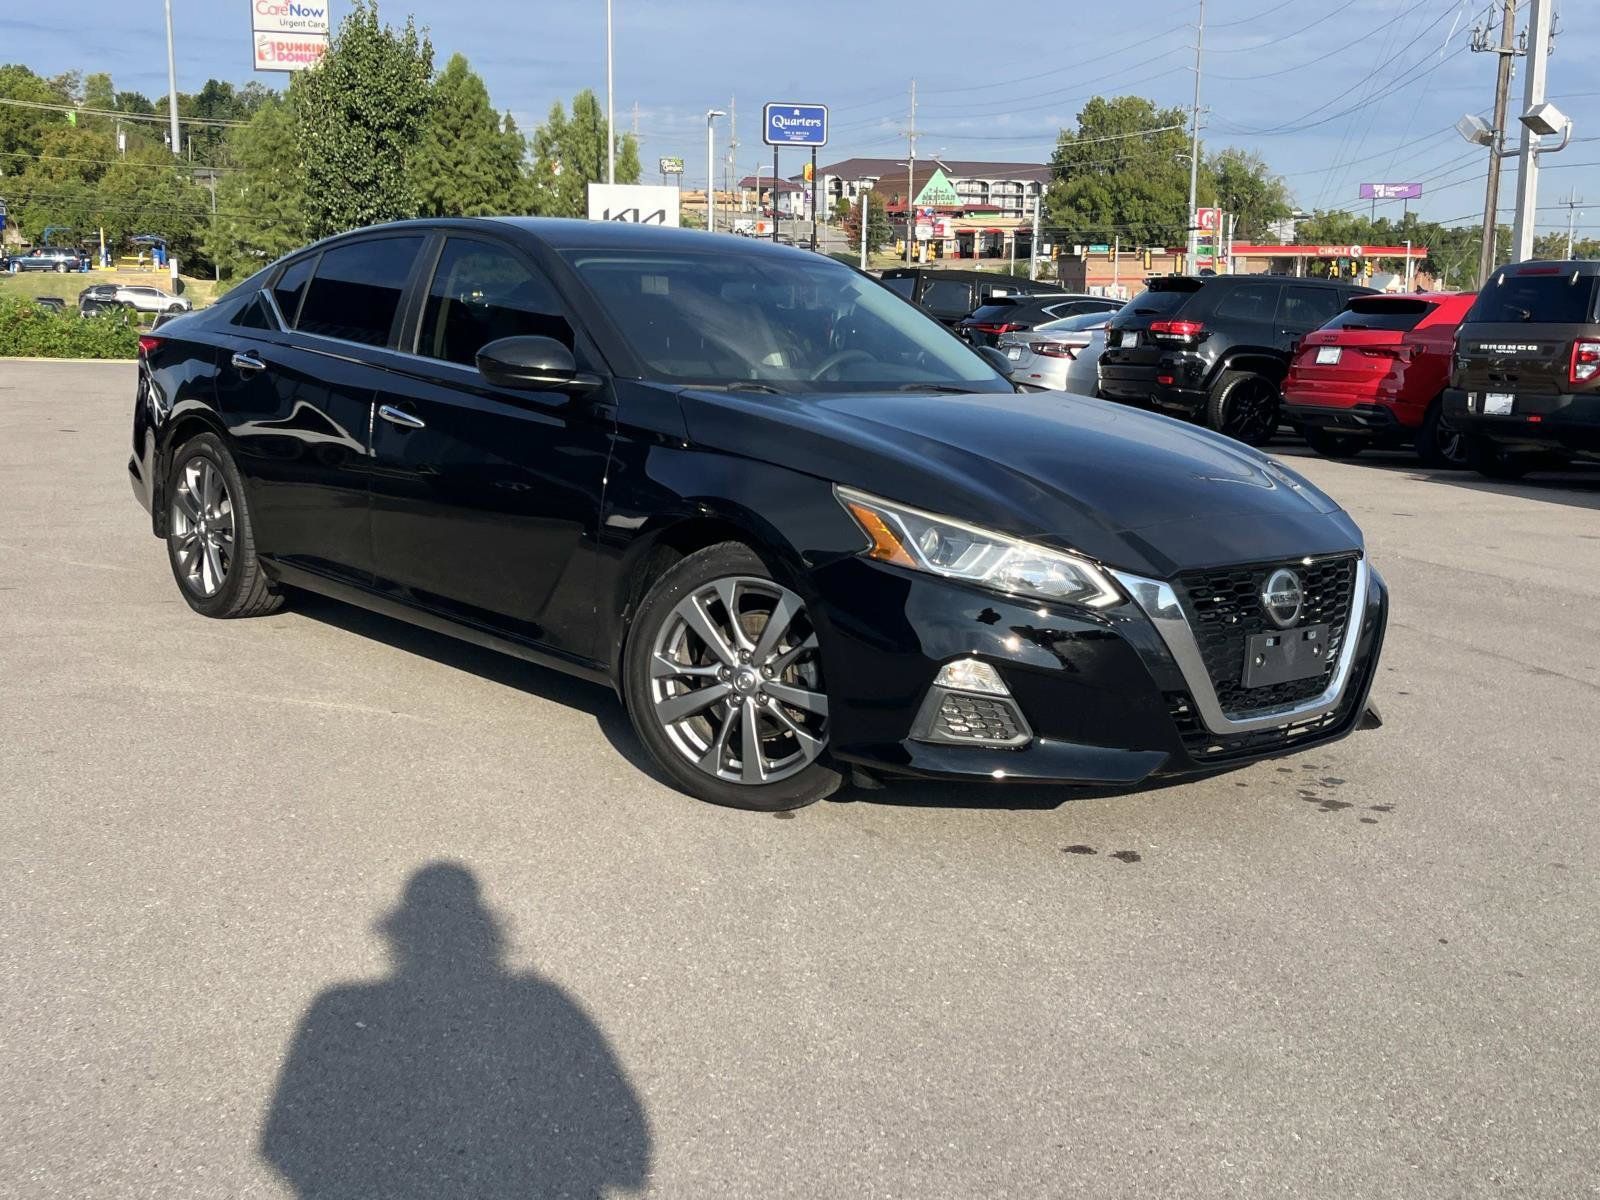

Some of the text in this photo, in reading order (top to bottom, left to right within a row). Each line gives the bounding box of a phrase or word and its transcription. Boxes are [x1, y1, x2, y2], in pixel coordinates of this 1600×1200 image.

[279, 18, 326, 28] Urgent Care
[277, 52, 320, 62] DONUT
[771, 114, 822, 130] Quarters
[1318, 247, 1348, 255] CIRCLE
[1479, 343, 1538, 351] BRONCO
[1269, 592, 1298, 603] NISSAN
